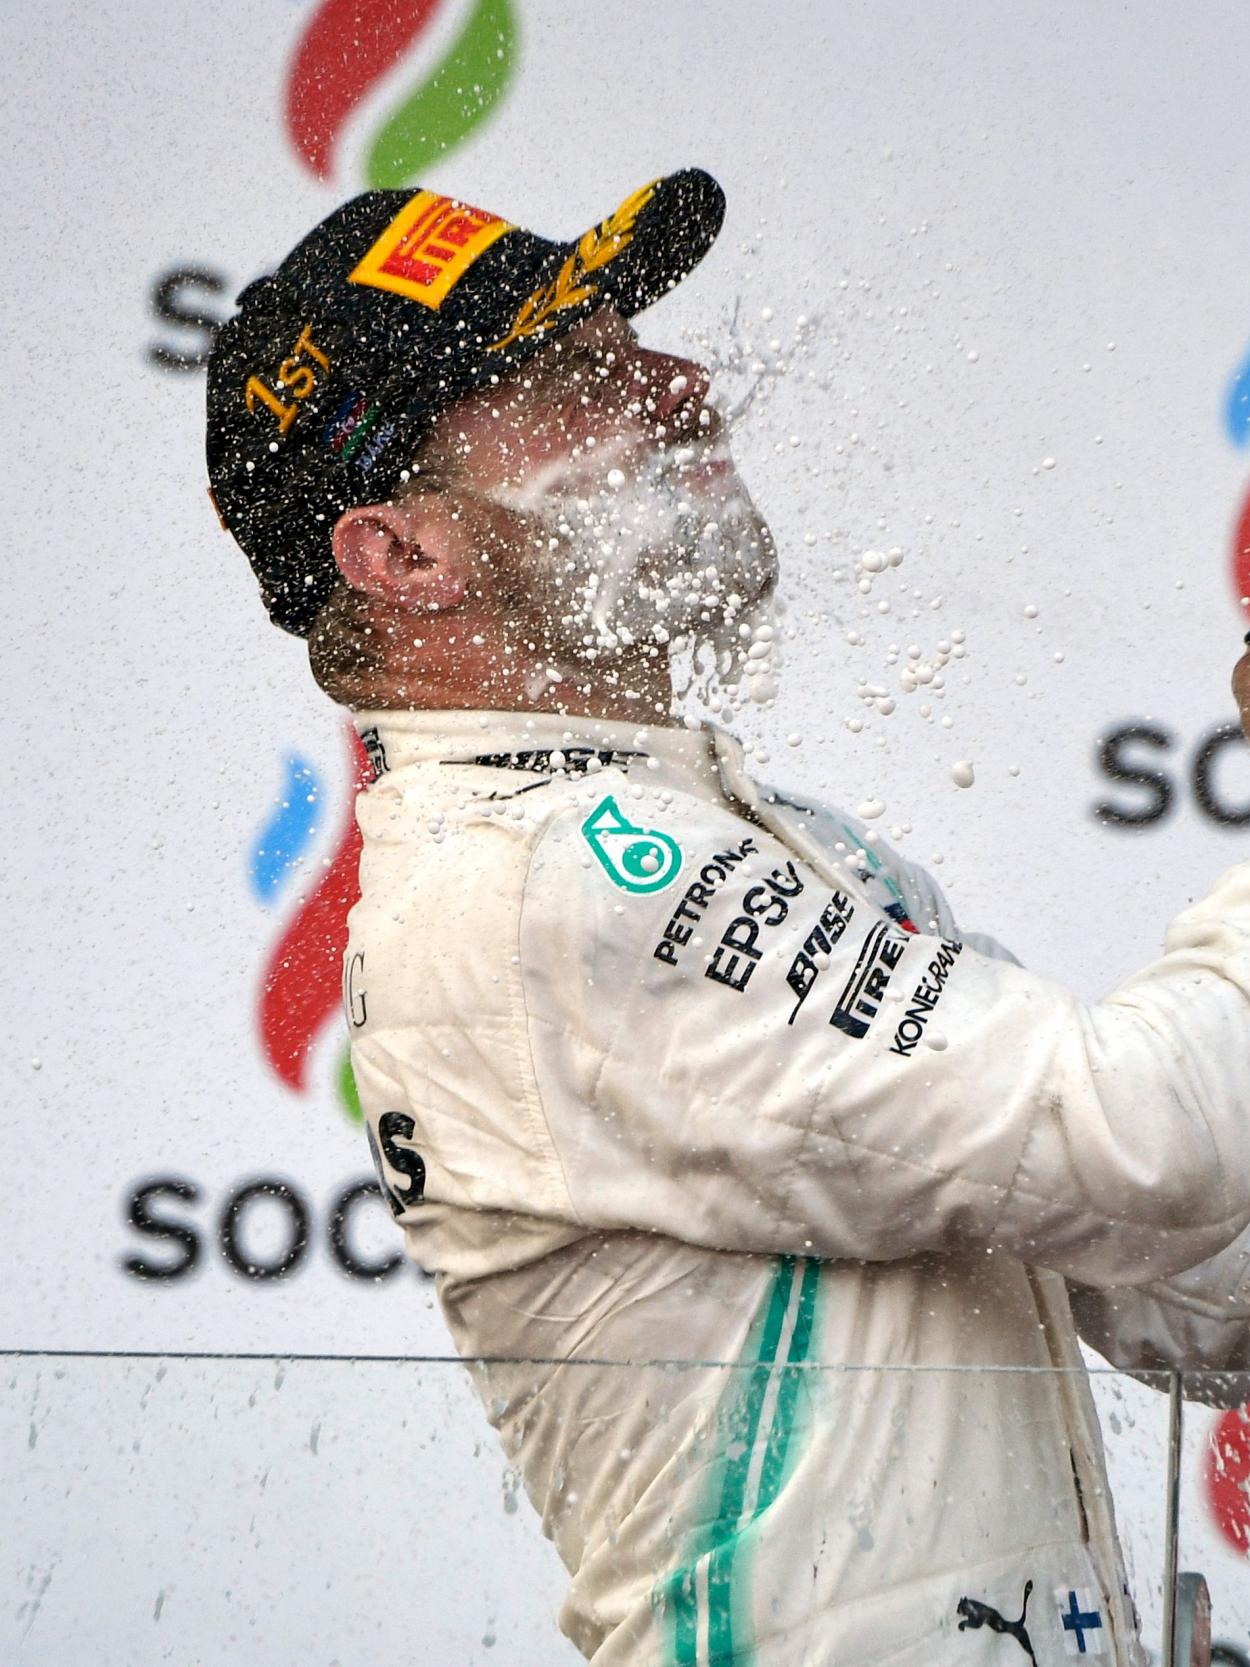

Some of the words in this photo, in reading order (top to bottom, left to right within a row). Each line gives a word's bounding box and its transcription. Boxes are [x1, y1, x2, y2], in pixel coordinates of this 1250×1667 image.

[245, 322, 330, 436] 1ST
[889, 937, 963, 1057] KONECRAN
[124, 1178, 436, 1283] SOC
